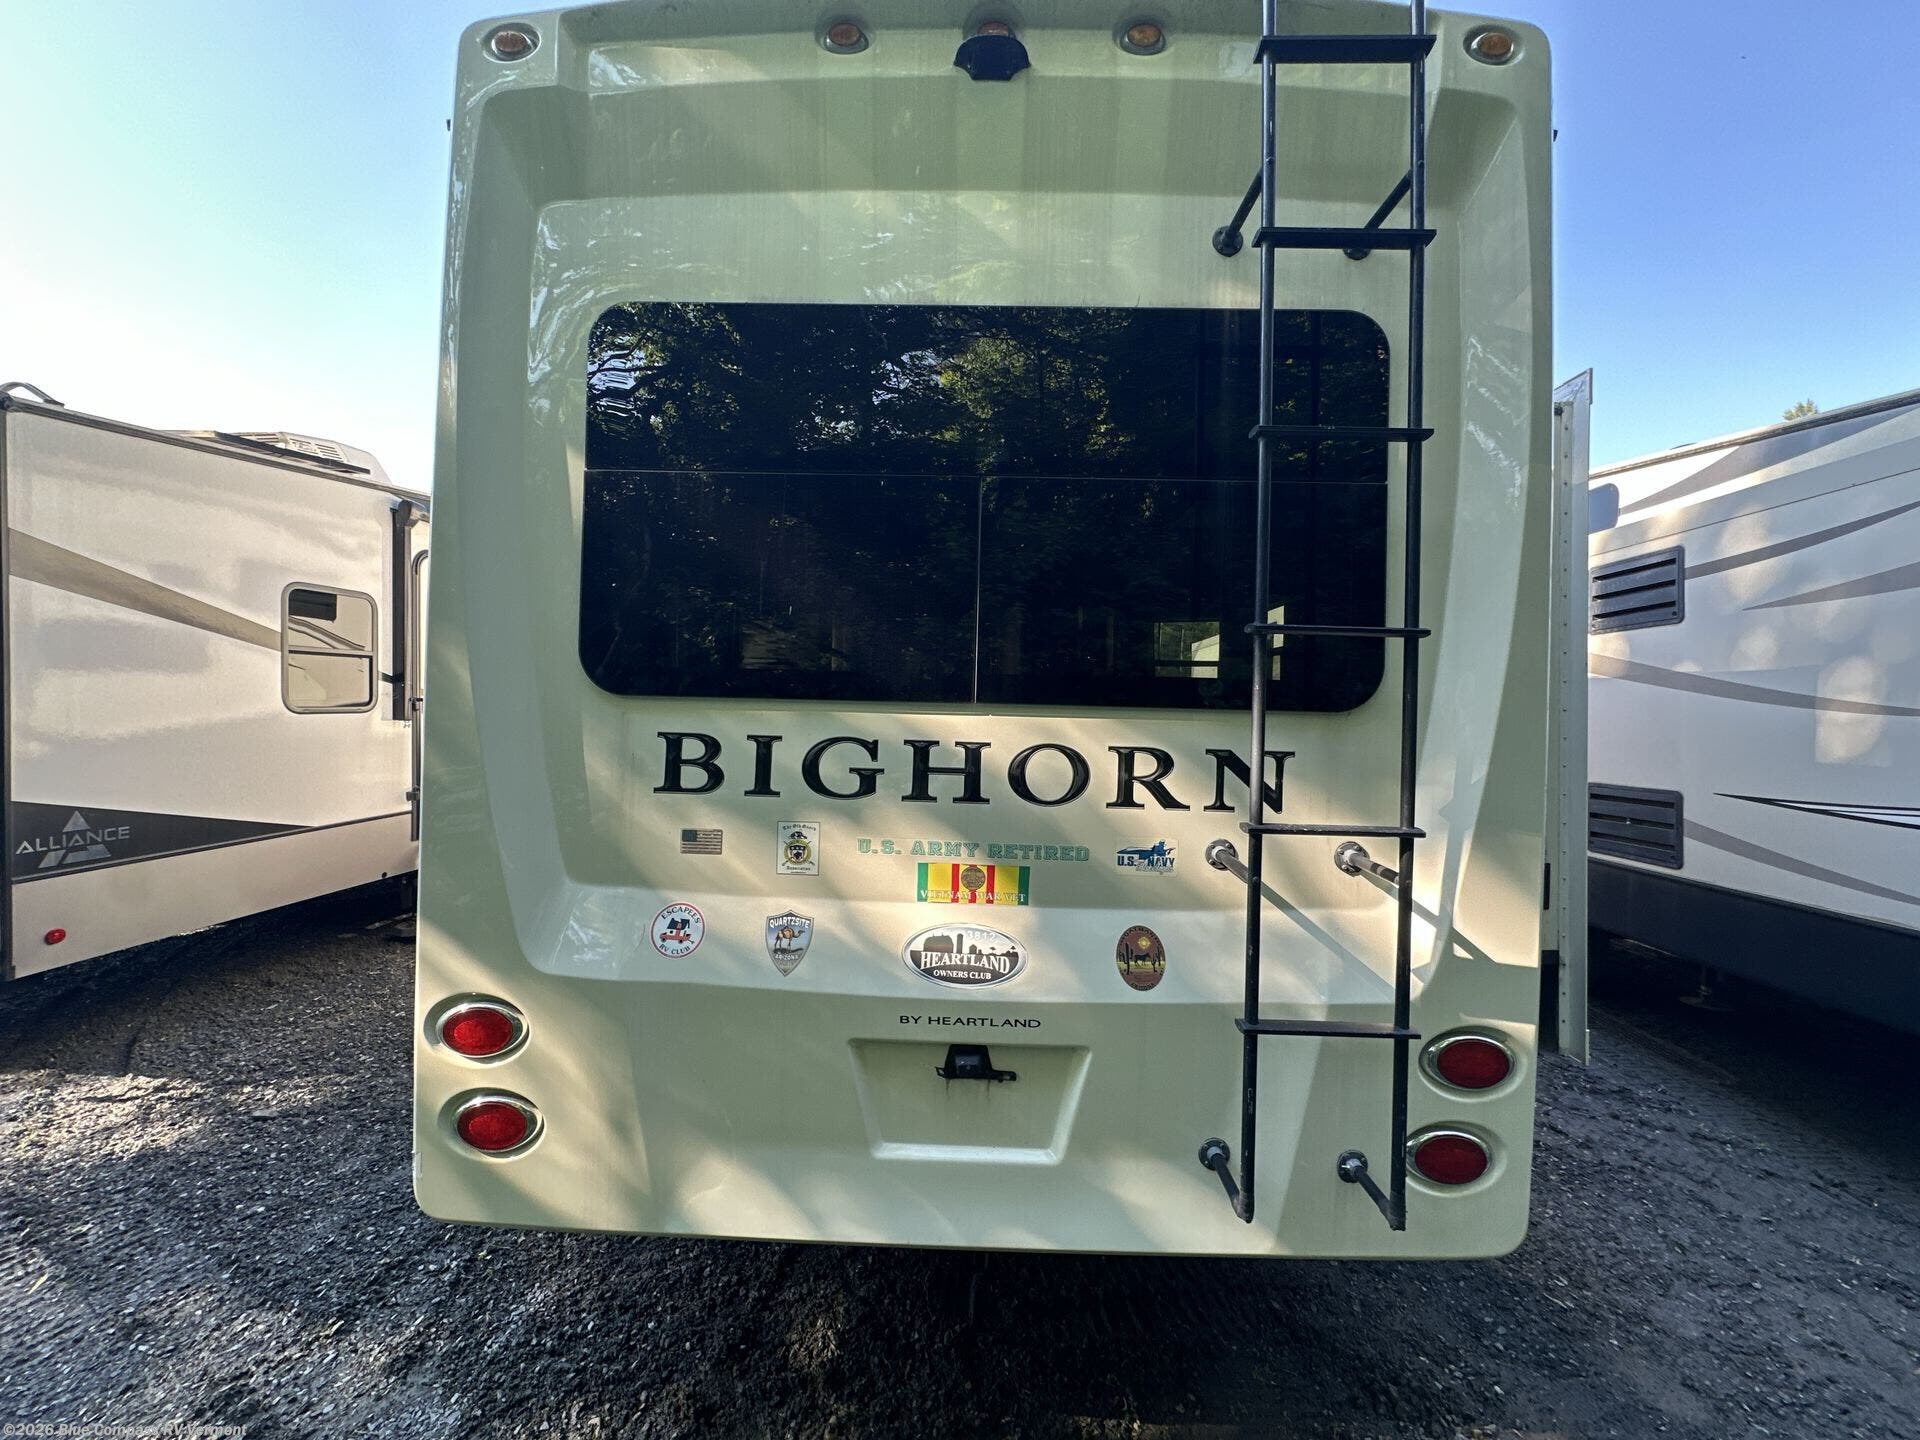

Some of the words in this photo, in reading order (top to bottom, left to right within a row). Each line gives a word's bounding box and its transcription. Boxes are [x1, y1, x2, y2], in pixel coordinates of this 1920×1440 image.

[653, 731, 1296, 815] BIGHORN
[16, 826, 131, 855] ALLIANCE
[857, 838, 901, 855] U.S.
[910, 839, 980, 857] ARMY
[986, 843, 1090, 862] RETIRED
[1117, 855, 1137, 867] U.S.
[661, 906, 702, 924] ESCAPEES
[769, 916, 811, 929] QUARTZSITE
[659, 943, 670, 952] RV
[671, 945, 691, 955] CLUB
[920, 951, 1011, 974] HEARTLAND
[933, 969, 968, 980] OWNERS
[969, 971, 992, 980] CLUB
[899, 1015, 922, 1025] BY
[928, 1016, 1042, 1029] HEARTLAND
